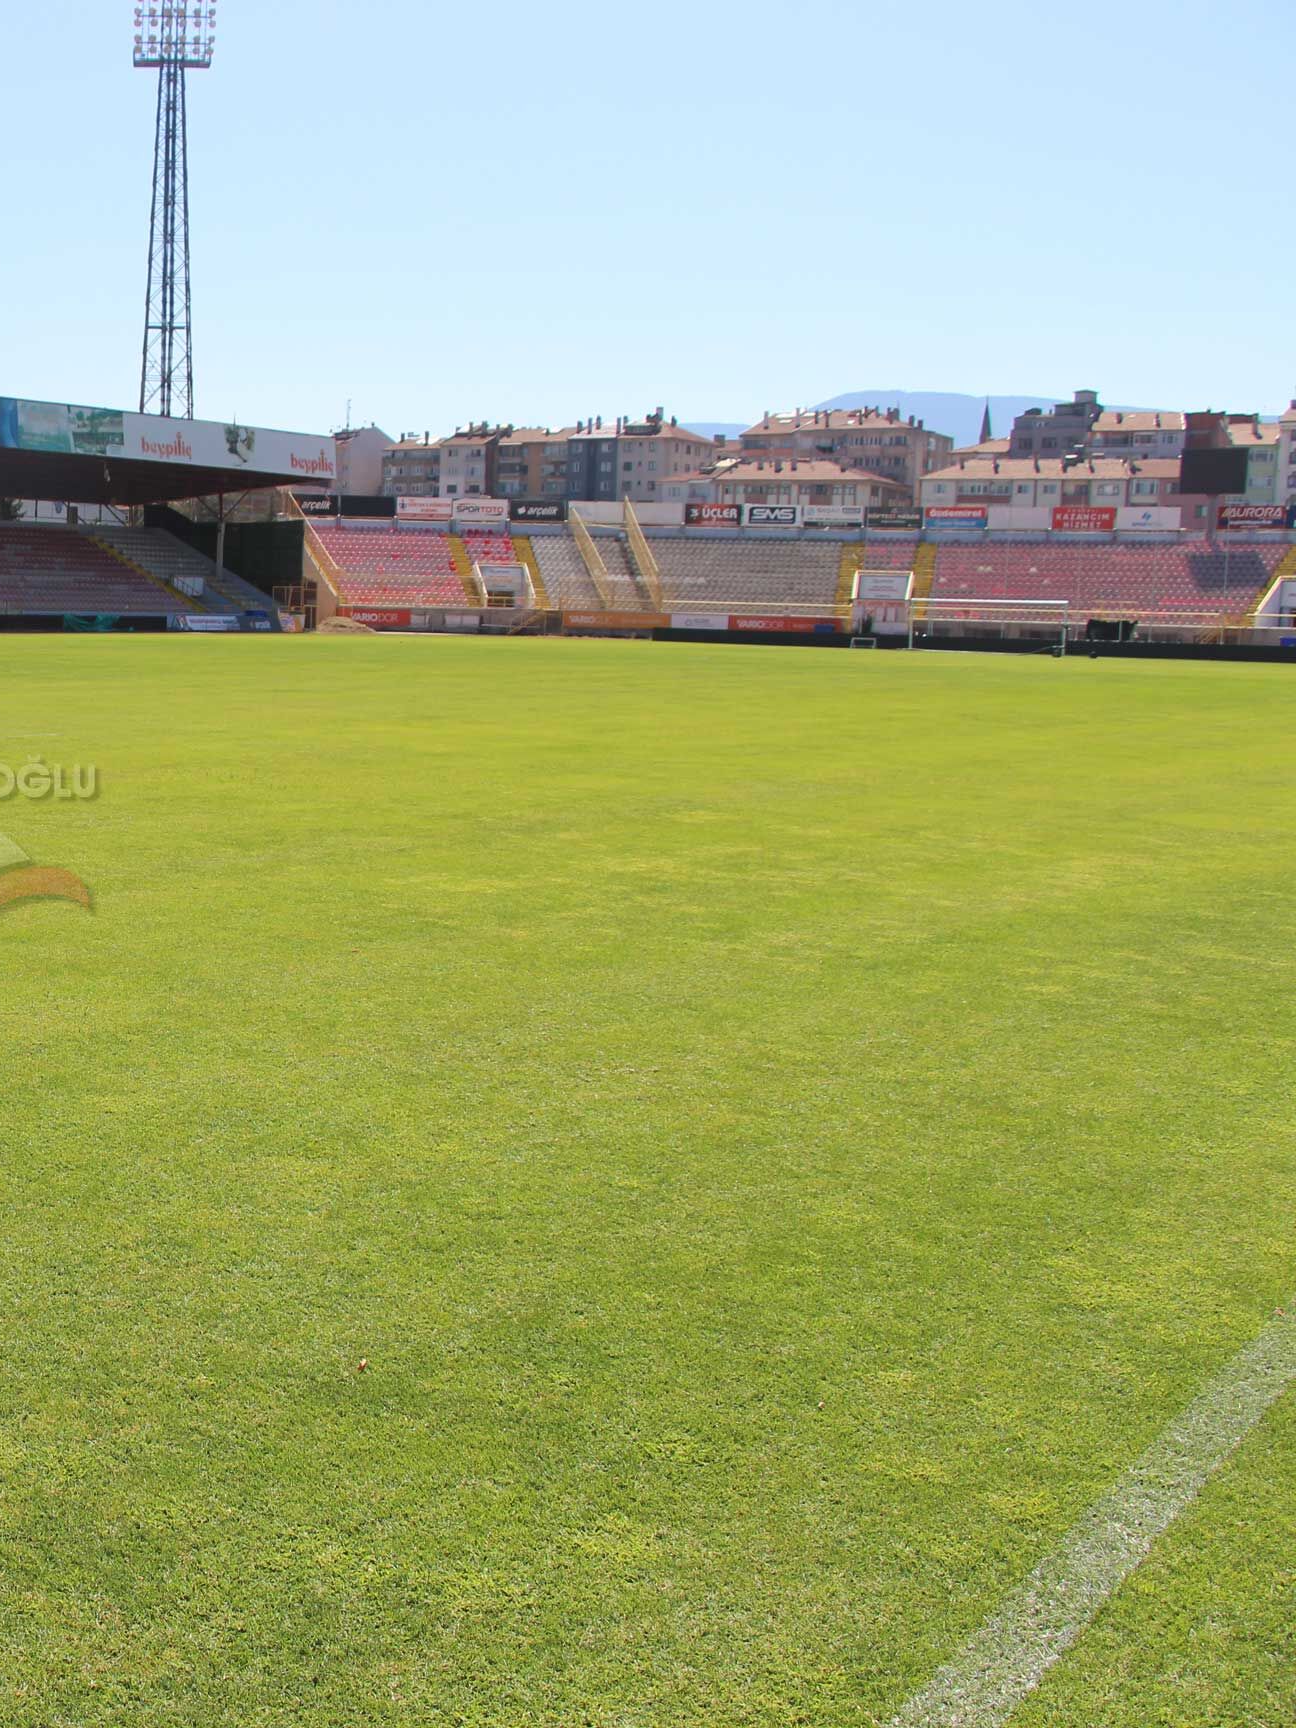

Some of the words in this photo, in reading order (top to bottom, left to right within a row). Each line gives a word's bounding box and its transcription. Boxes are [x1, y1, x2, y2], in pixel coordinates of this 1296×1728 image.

[141, 432, 192, 459] beypiliç
[301, 500, 331, 511] arçelik
[702, 505, 738, 522] ÜÇLER
[751, 508, 794, 519] SMS
[1224, 507, 1282, 518] AURORA
